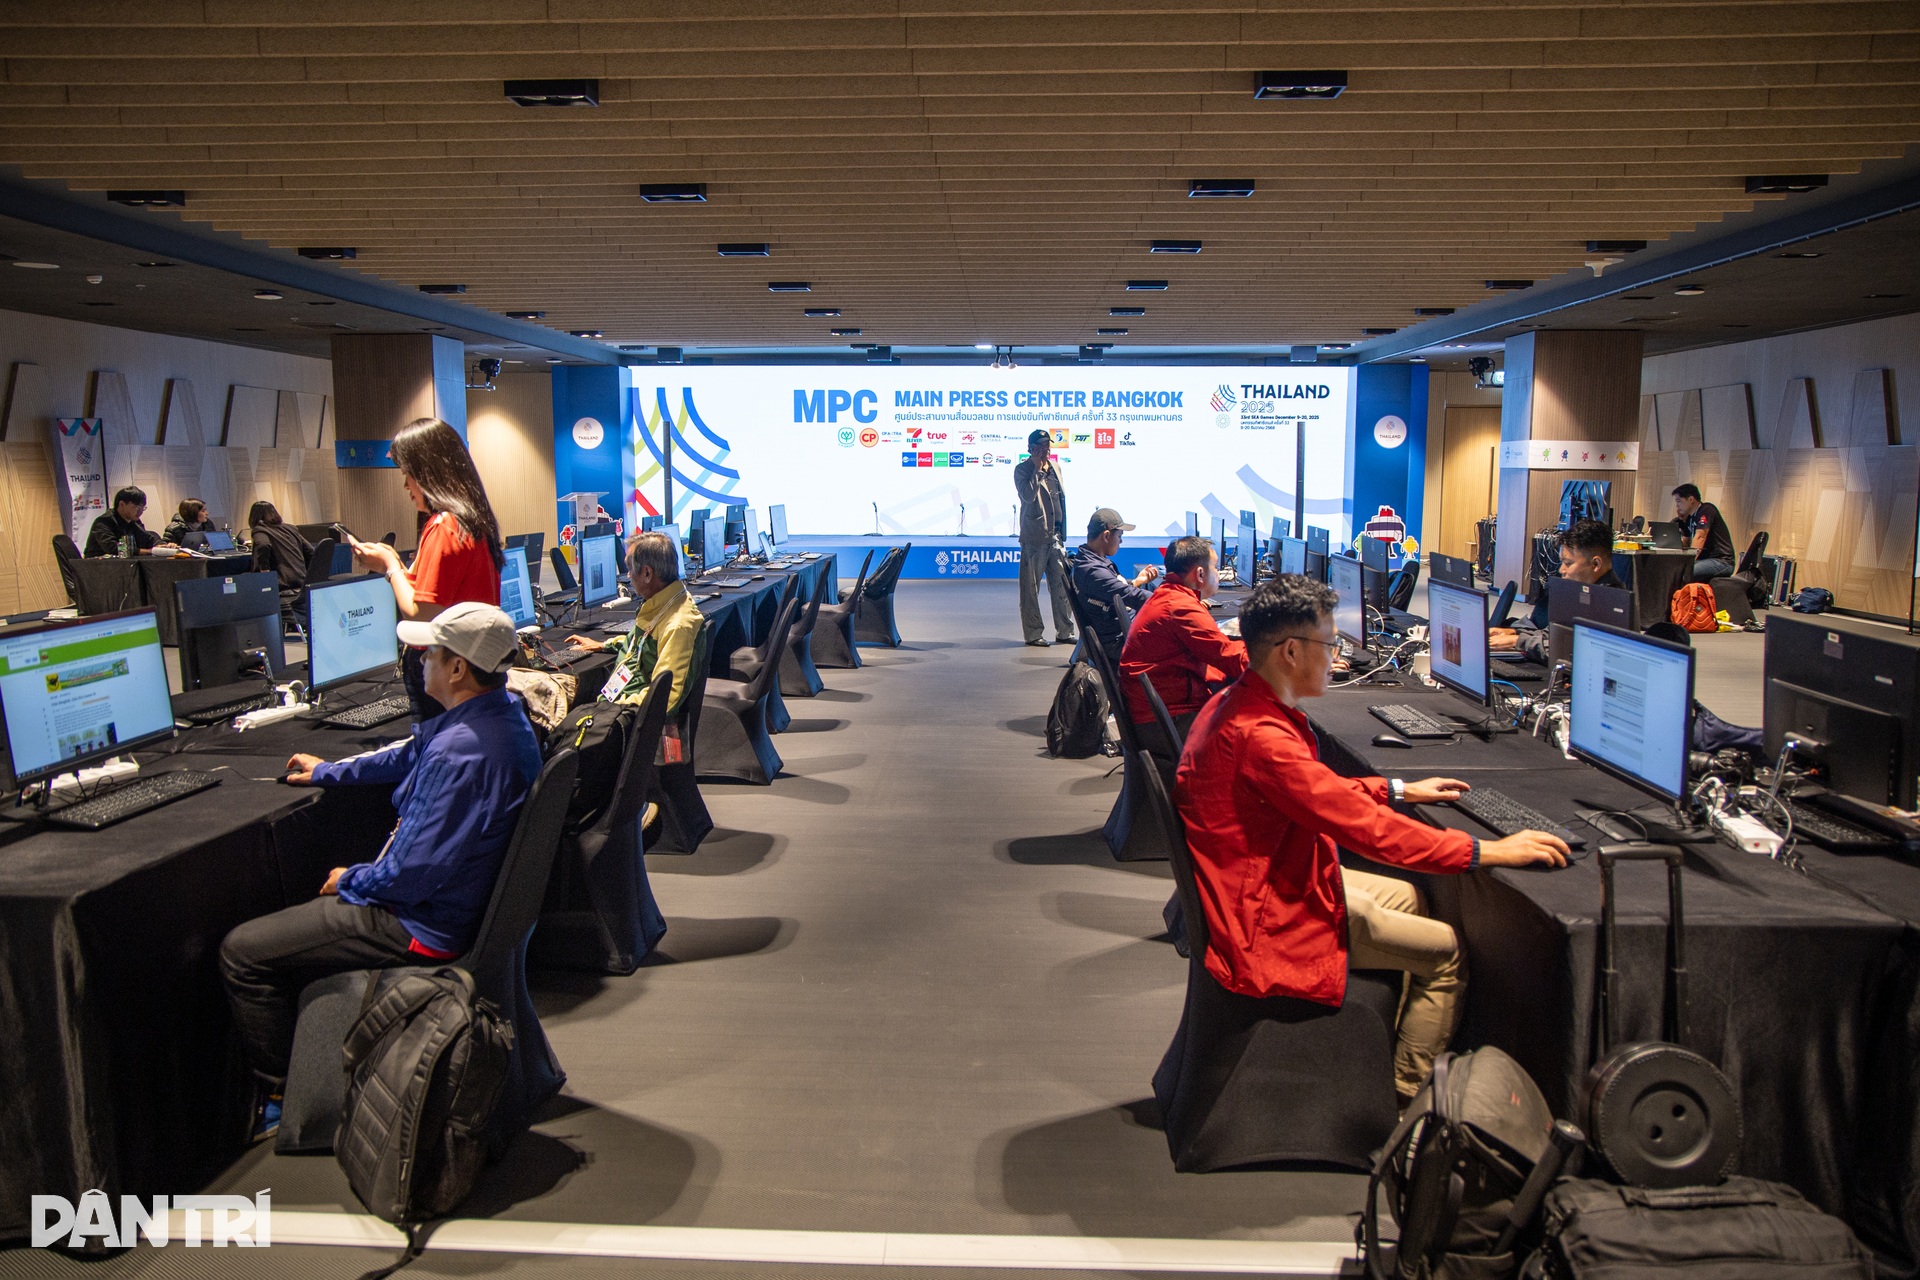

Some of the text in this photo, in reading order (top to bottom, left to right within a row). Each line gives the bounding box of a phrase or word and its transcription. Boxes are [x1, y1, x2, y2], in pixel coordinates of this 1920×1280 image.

[1240, 384, 1331, 399] THAILAND
[894, 390, 1184, 407] MAIN PRESS CENTER BANGKOK
[793, 389, 878, 424] MPC
[1240, 401, 1275, 413] 2025
[894, 409, 994, 423] ศูนย์ประสานงานสื่อมวลชน
[1106, 412, 1118, 421] 33
[1119, 412, 1183, 423] กรุงเทพมหานคร
[861, 433, 877, 443] CP
[927, 431, 947, 440] true
[951, 551, 1022, 563] THAILAND
[951, 564, 980, 574] 2025
[347, 606, 375, 619] THAILAND
